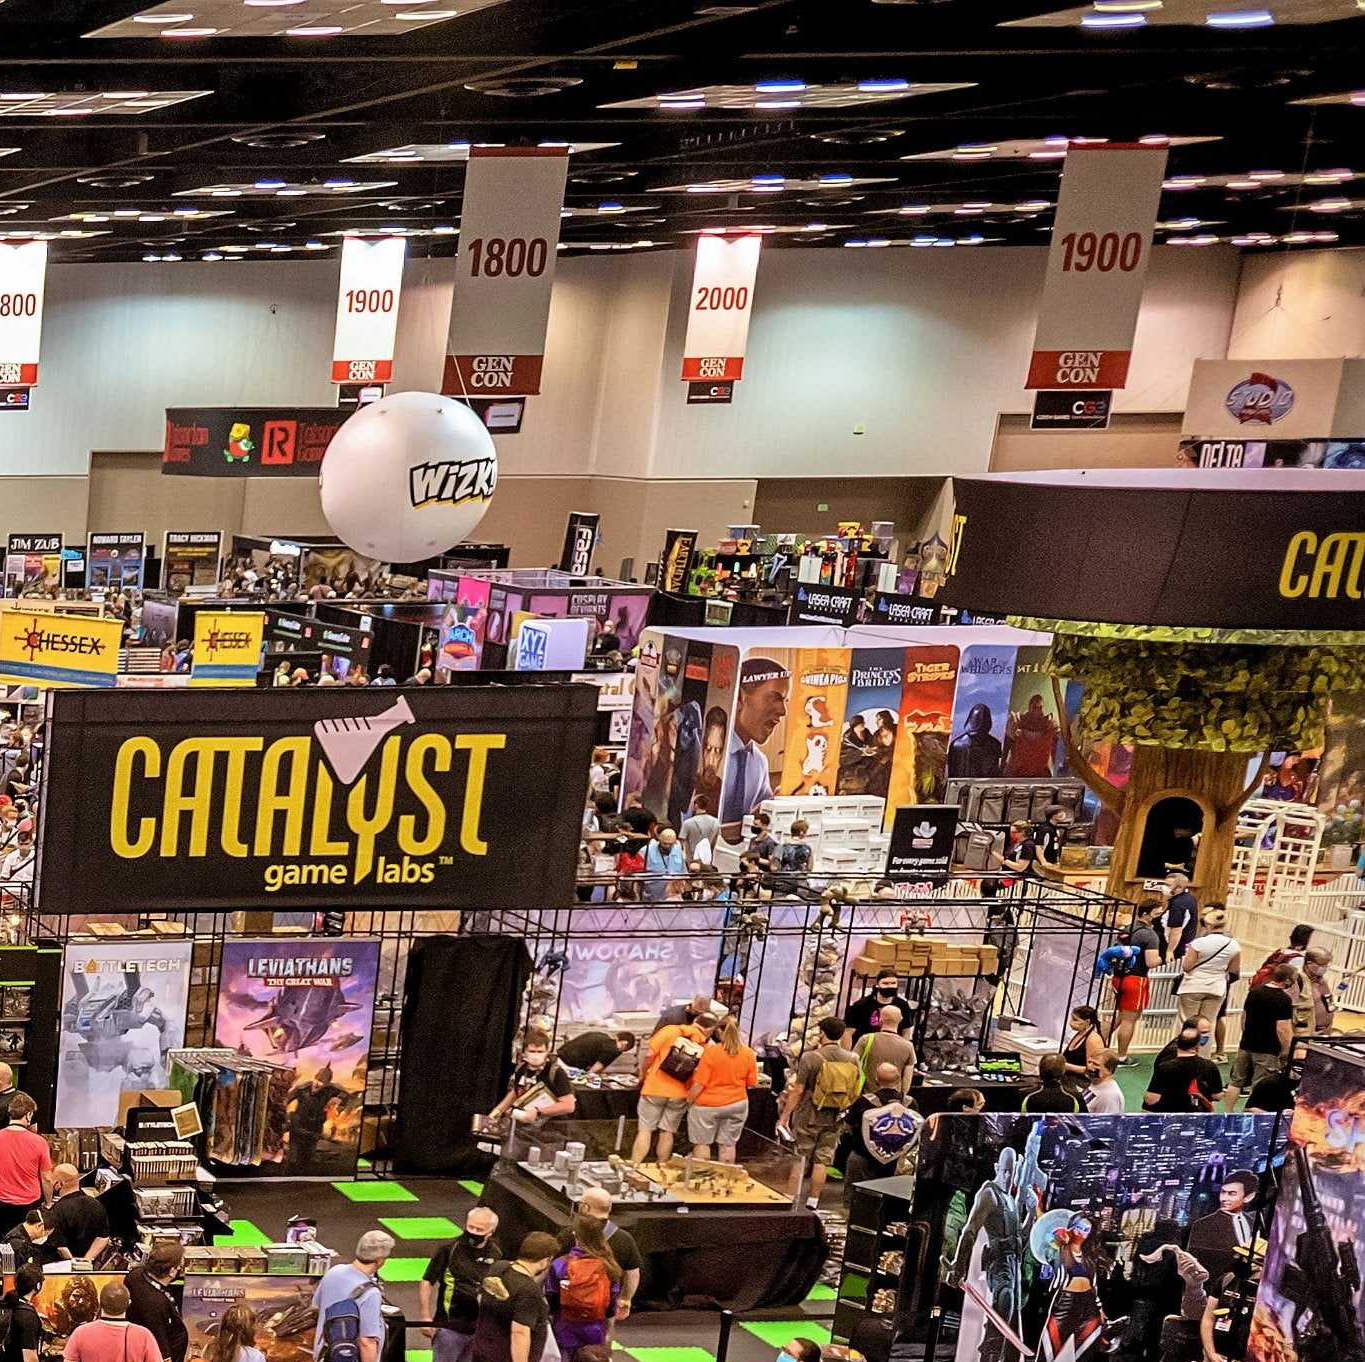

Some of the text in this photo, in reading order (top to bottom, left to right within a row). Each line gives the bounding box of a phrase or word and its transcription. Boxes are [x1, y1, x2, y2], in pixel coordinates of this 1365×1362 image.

[468, 237, 547, 278] 1800
[1060, 232, 1142, 273] 1900
[346, 289, 393, 313] 1900
[696, 287, 748, 310] 2000
[472, 357, 515, 372] GEN
[1058, 352, 1103, 367] GEN
[470, 372, 514, 388] CON
[1056, 368, 1100, 383] CON
[10, 538, 60, 550] JIM ZUB
[111, 733, 508, 884] CATALYST
[264, 860, 348, 892] game
[247, 957, 354, 979] LEVIATHANS
